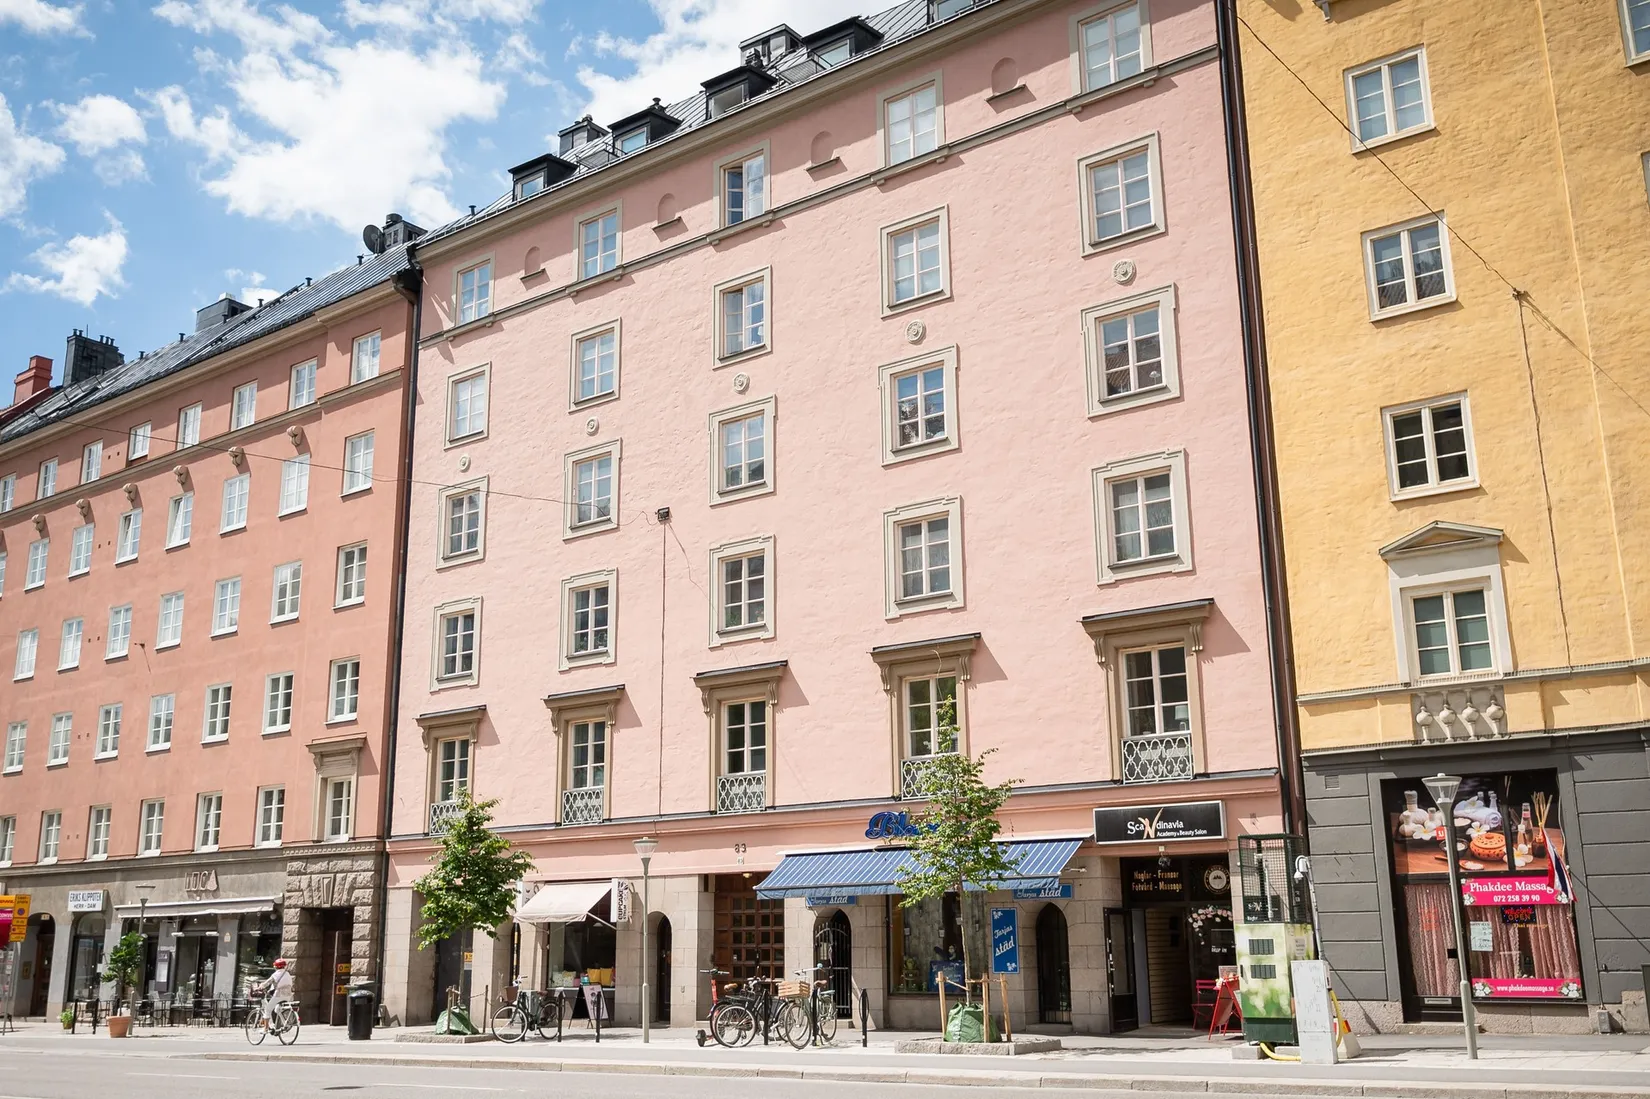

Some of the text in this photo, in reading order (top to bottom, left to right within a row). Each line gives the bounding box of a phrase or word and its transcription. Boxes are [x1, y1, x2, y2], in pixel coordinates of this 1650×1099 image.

[1194, 828, 1208, 836] Salon
[1469, 881, 1554, 894] Phakdee Massag
[1522, 894, 1530, 902] 39
[1531, 894, 1540, 902] 90
[995, 936, 1015, 957] städ
